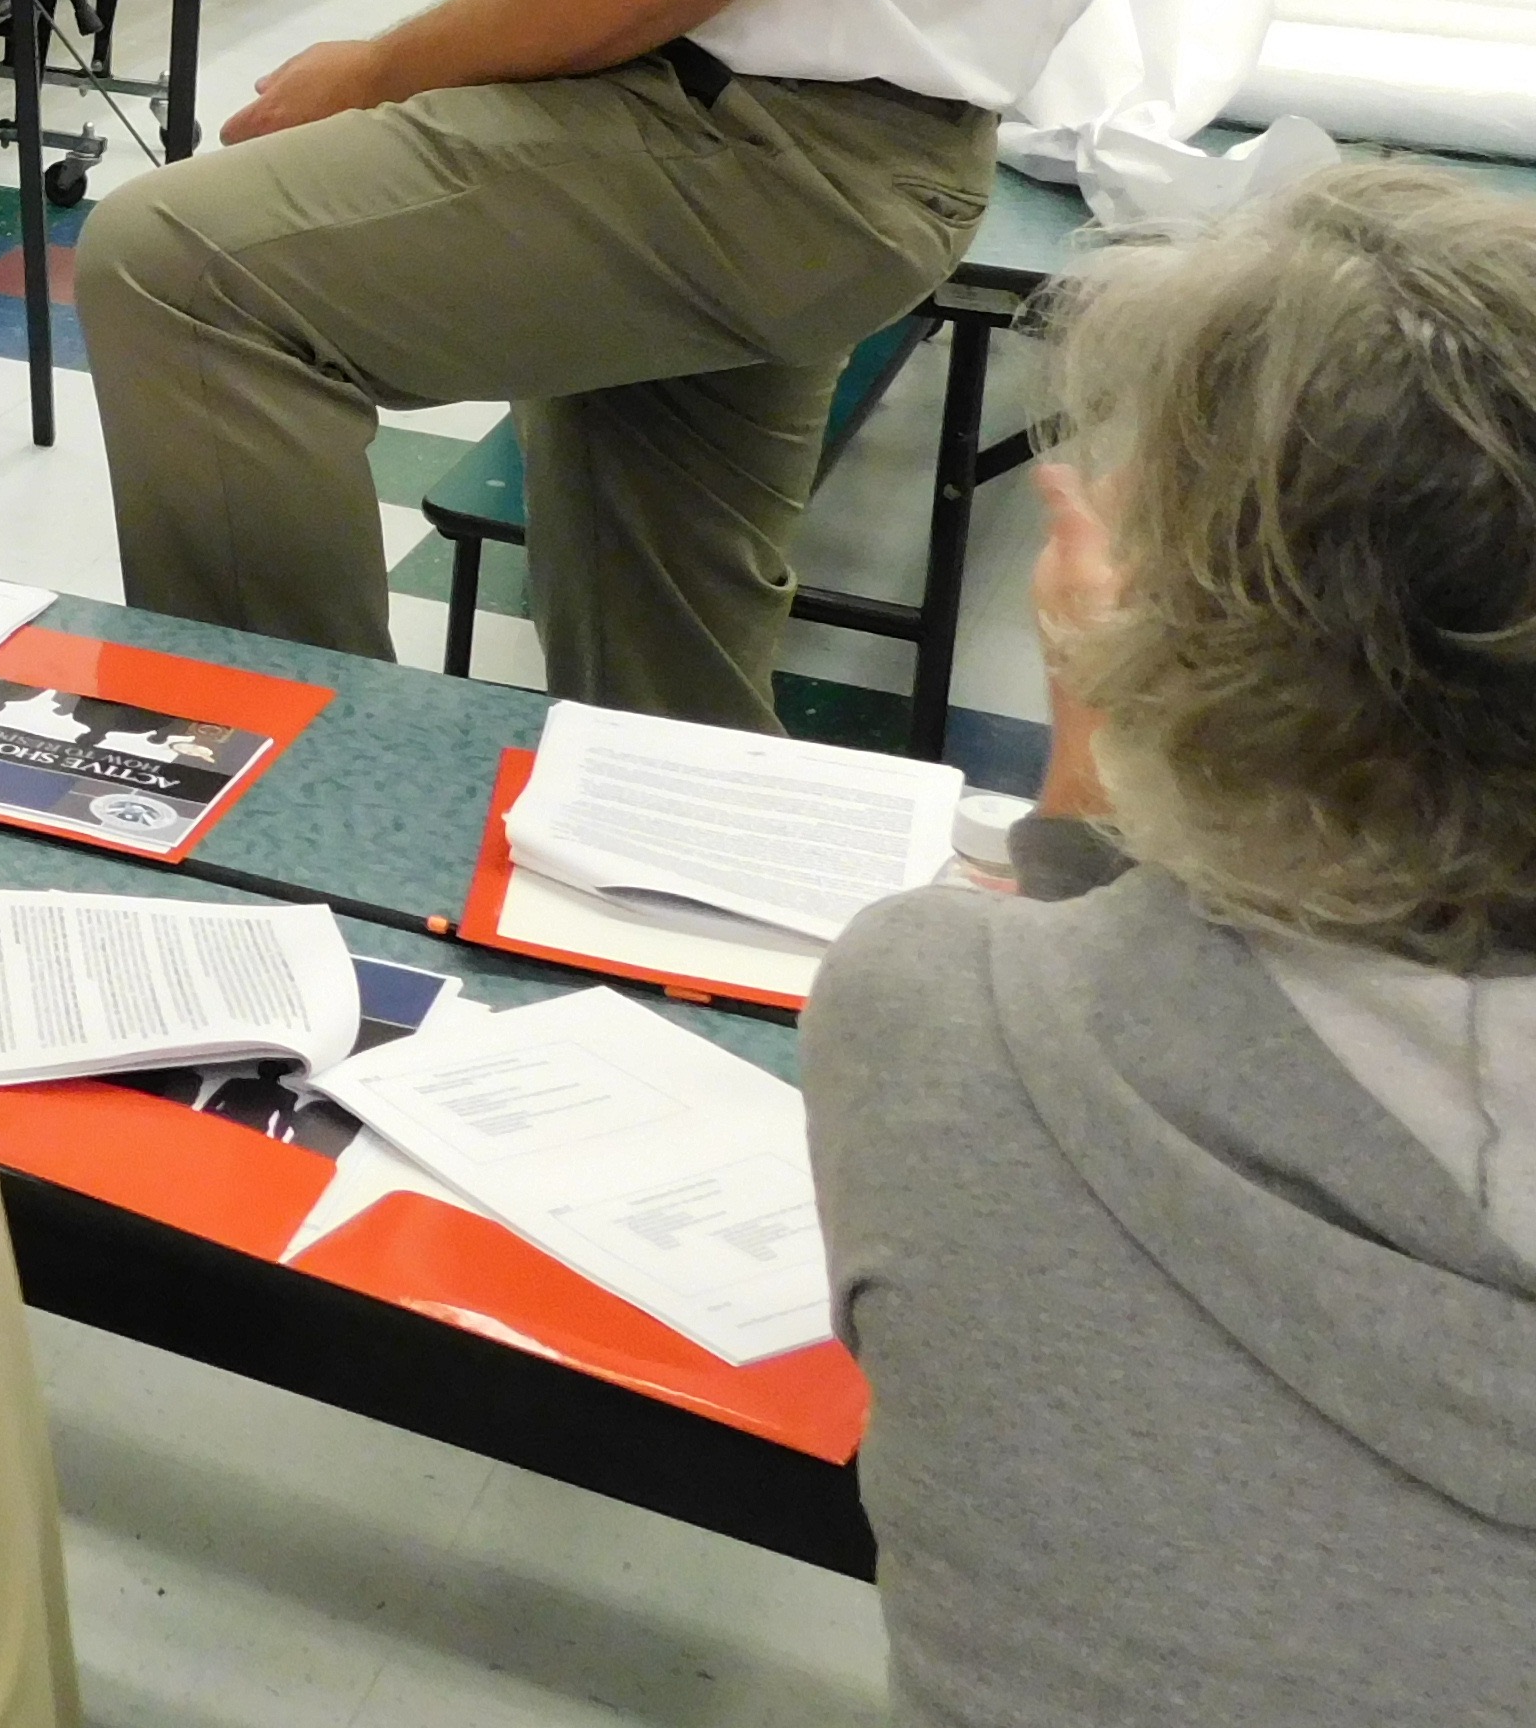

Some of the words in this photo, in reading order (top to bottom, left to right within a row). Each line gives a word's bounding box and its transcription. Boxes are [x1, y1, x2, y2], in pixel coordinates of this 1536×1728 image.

[67, 748, 95, 760] TO
[106, 753, 161, 773] HOW
[59, 757, 181, 789] ACTIVE
